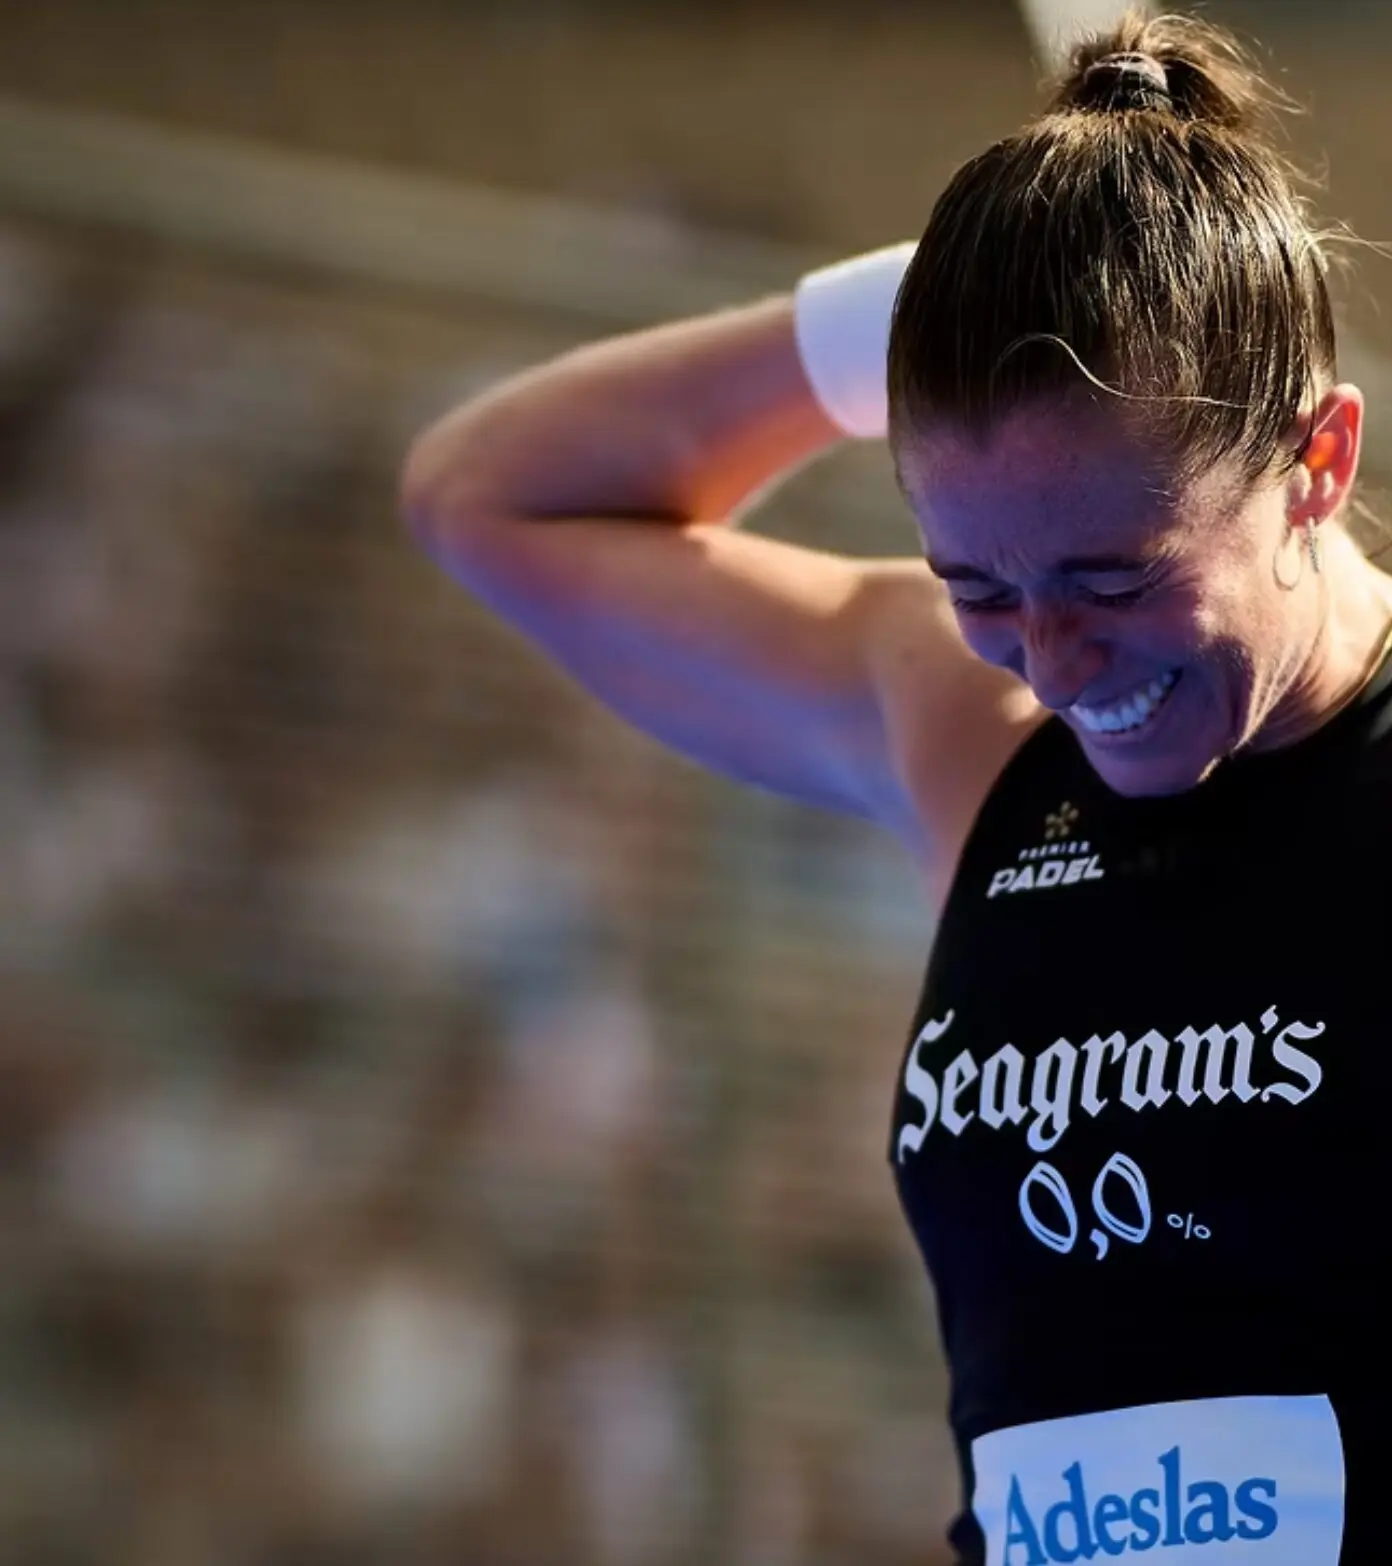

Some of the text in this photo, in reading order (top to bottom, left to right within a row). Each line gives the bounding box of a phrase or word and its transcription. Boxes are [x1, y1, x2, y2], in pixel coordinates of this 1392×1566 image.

[986, 853, 1105, 898] PADEL
[897, 1003, 1327, 1165] Seagram's
[1002, 1445, 1280, 1566] Adeslas
